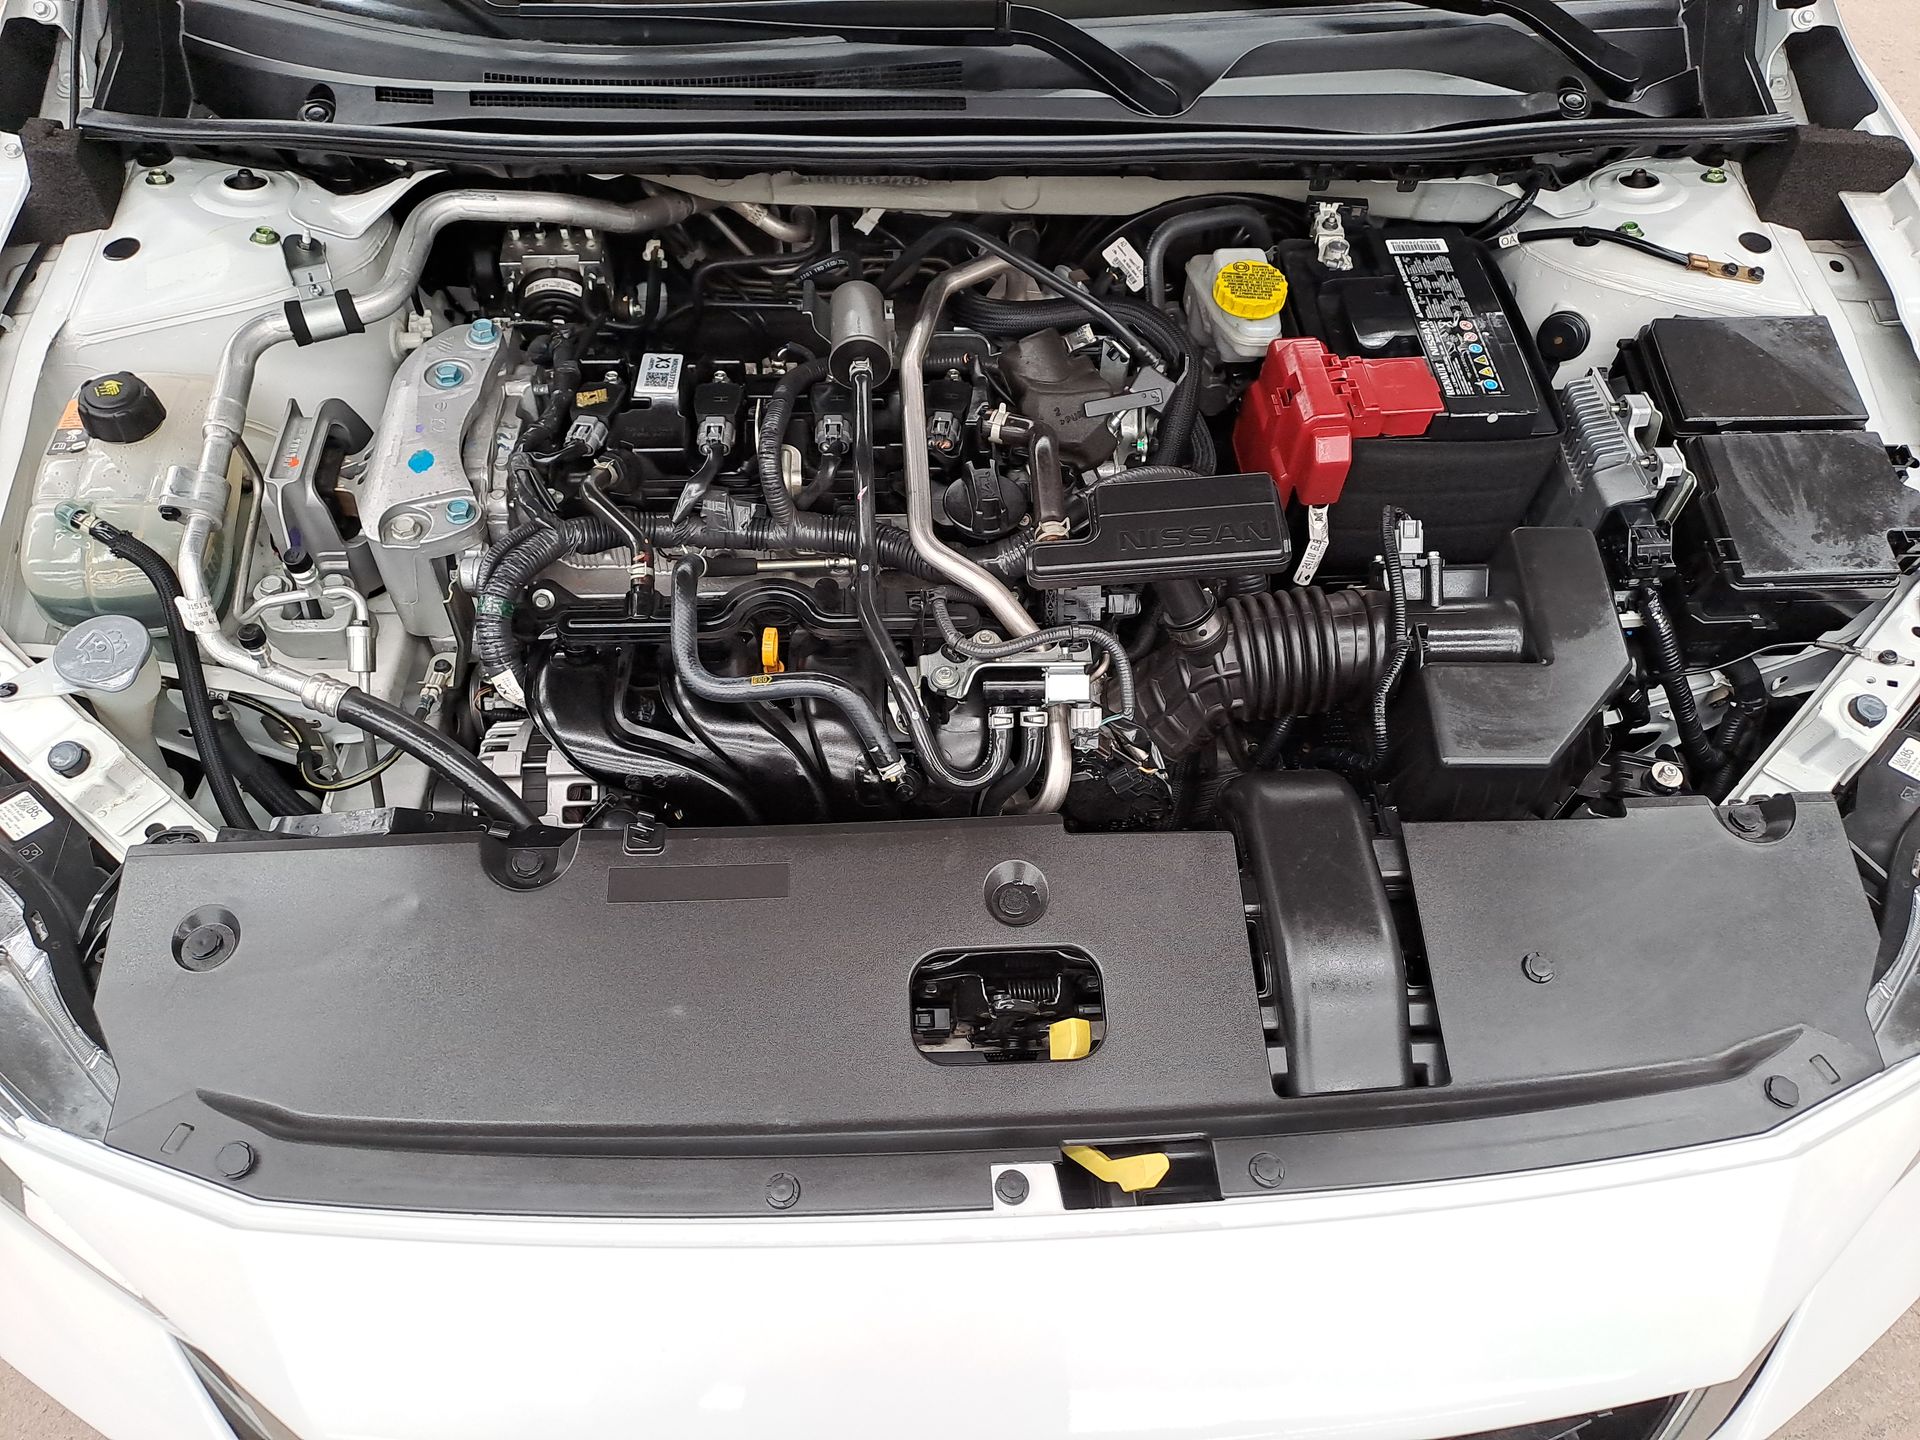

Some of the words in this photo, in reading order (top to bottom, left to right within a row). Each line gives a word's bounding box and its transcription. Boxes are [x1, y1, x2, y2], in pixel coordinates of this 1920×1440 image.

[1419, 320, 1440, 357] NISSAN
[655, 356, 672, 369] X3
[1434, 362, 1456, 396] RENAULT
[1119, 520, 1271, 551] NISSAN
